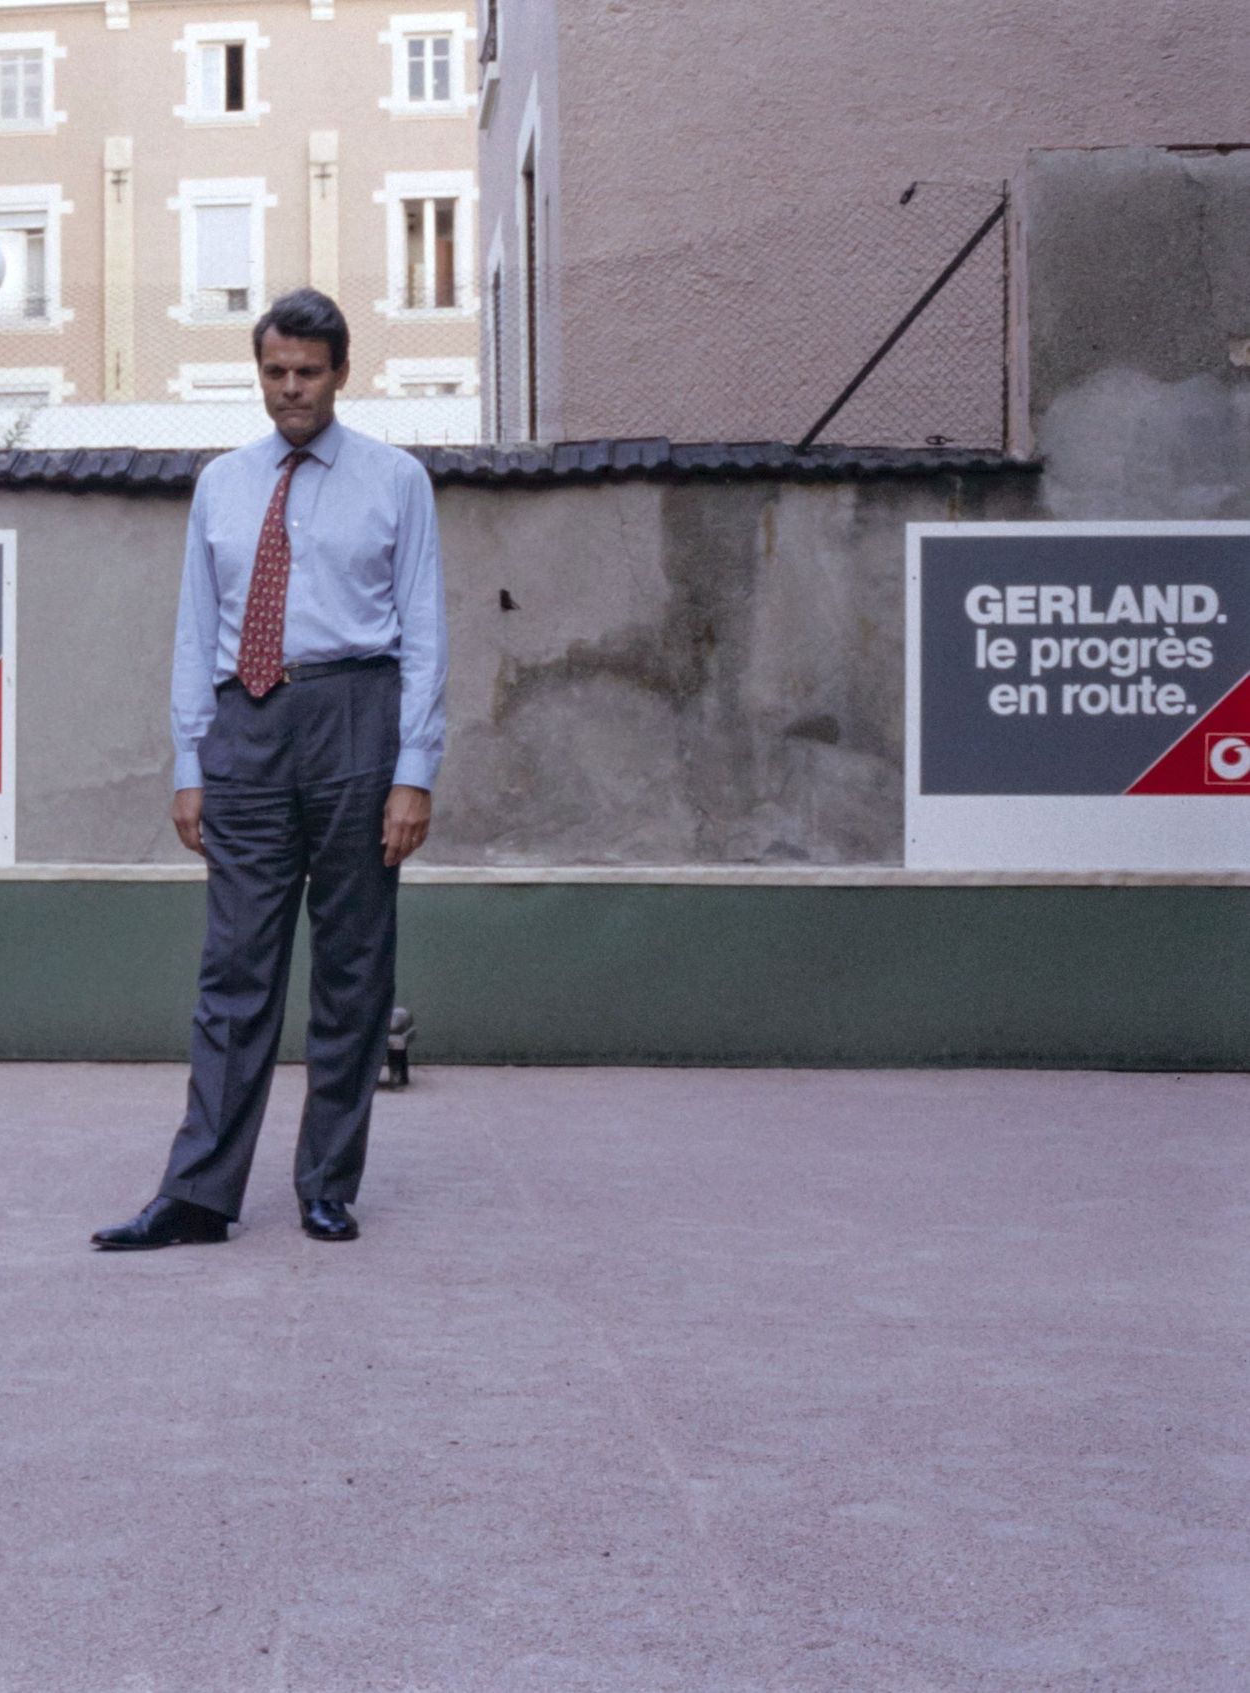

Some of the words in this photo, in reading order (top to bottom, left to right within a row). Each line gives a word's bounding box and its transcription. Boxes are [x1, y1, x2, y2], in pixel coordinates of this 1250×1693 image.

[965, 584, 1227, 625] GERLAND.
[976, 628, 1017, 669] le
[1030, 627, 1214, 677] progrès
[988, 683, 1048, 715] en
[1062, 676, 1197, 715] route.
